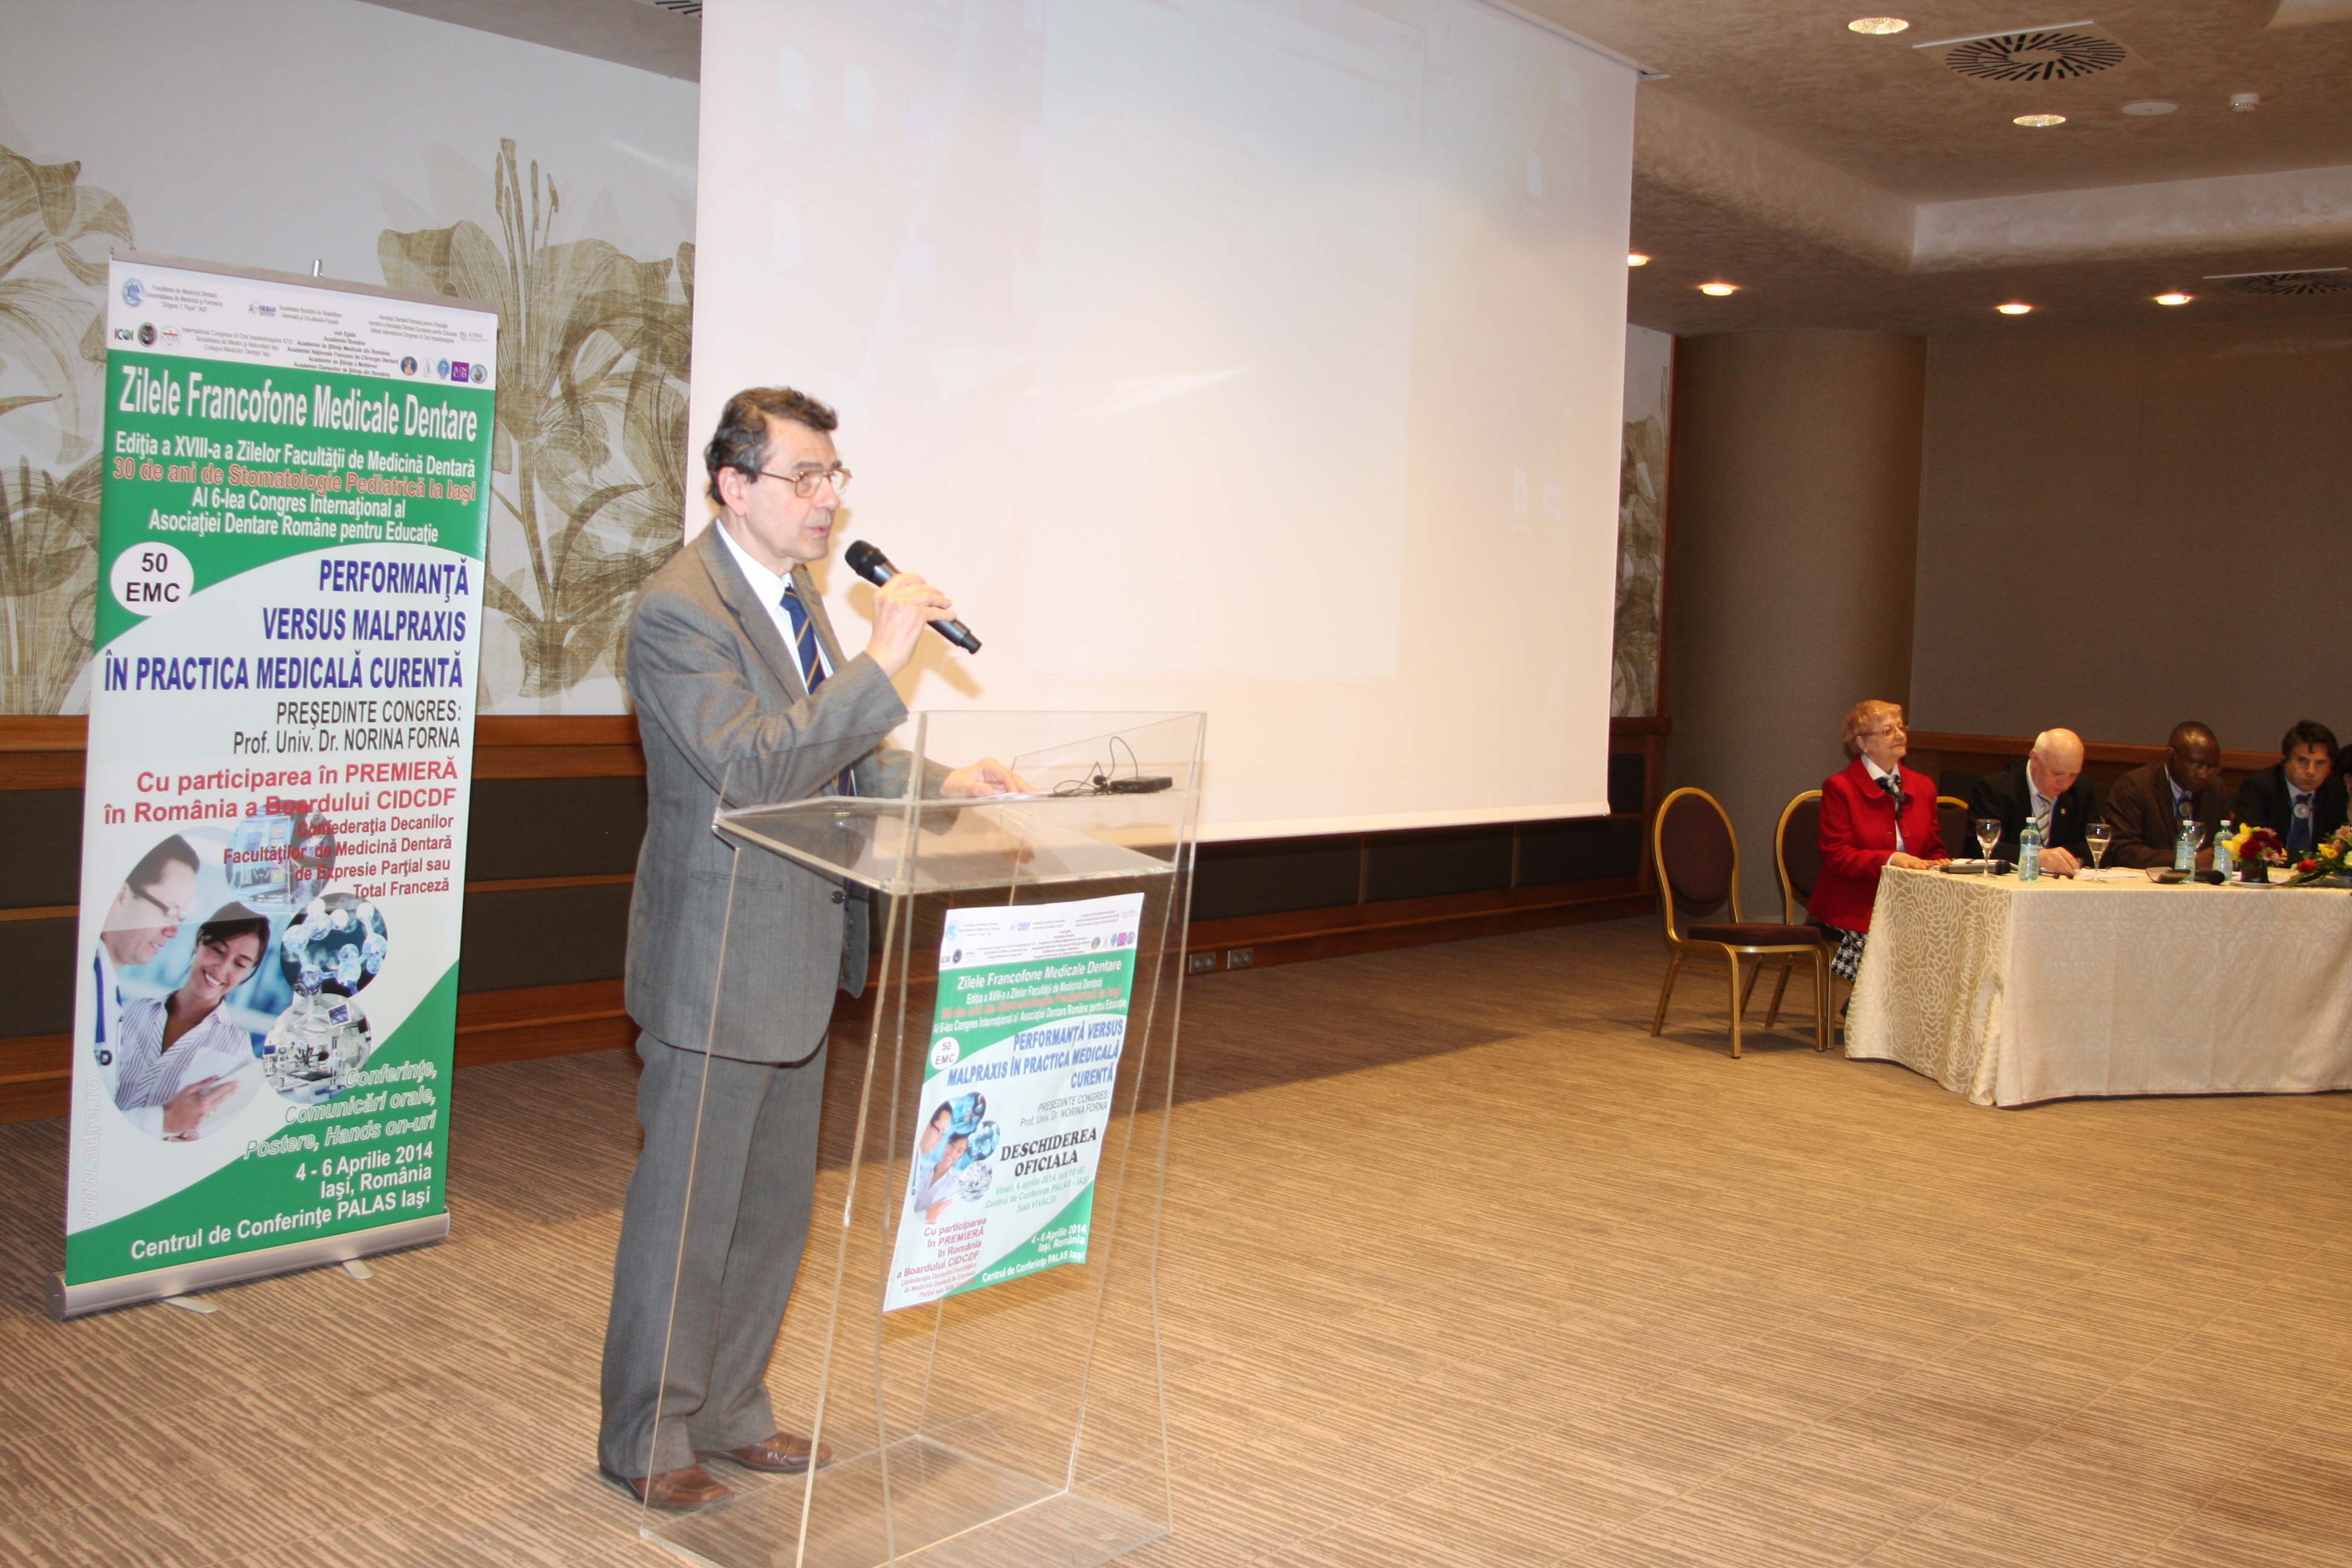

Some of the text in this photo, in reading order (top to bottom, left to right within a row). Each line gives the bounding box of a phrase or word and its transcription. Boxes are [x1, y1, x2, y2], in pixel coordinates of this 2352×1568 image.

[119, 365, 477, 442] Zilele Francofone Medicale Dentare
[161, 439, 171, 456] a
[174, 435, 221, 459] XVIII-a
[224, 444, 233, 460] a
[235, 440, 281, 463] Zilelor
[348, 449, 364, 469] de
[367, 450, 423, 474] Medicină
[426, 455, 475, 478] Dentară
[112, 456, 136, 479] 30
[139, 458, 164, 481] de
[167, 461, 197, 483] ani
[200, 462, 224, 485] de
[227, 463, 342, 495] Stomatologie
[345, 471, 425, 501] Pediatrică
[428, 478, 443, 498] la
[191, 486, 208, 507] Al
[211, 487, 246, 509] 6-lea
[248, 489, 307, 515] Congres
[394, 500, 406, 518] al
[224, 512, 279, 535] Dentare
[282, 517, 337, 538] Române
[339, 519, 382, 541] pentru
[141, 553, 168, 573] 50
[126, 583, 181, 603] EMC
[263, 607, 465, 641] VERSUS MALPRAXIS
[105, 649, 462, 691] ÎN PRACTICA MEDICALĂ CURENTĂ
[382, 700, 461, 722] CONGRES:
[234, 727, 460, 754] Prof. Univ. Dr. NORINA FORNA
[138, 757, 457, 795] Cu participarea în PREMIERĂ
[105, 788, 456, 824] în România a Boardului CIDCDF
[391, 815, 454, 831] Decanilor
[315, 845, 332, 859] de
[335, 839, 397, 858] Medicină
[401, 836, 452, 852] Dentară
[293, 866, 312, 881] de
[315, 865, 377, 881] Expresie
[427, 860, 450, 871] sau
[354, 878, 449, 898] Total Franceză
[957, 975, 985, 990] Zilele
[987, 969, 1042, 986] Francofone
[1045, 963, 1085, 978] Medicale
[1087, 960, 1122, 974] Dentare
[1087, 1019, 1123, 1039] VERSUS
[935, 1053, 955, 1065] EMC
[942, 1042, 952, 1051] 50
[947, 1061, 1008, 1086] MALPRAXIS
[1010, 1056, 1021, 1077] ÎN
[1023, 1051, 1070, 1074] PRACTICA
[286, 1085, 436, 1125] Comunicări orale,
[1077, 1090, 1109, 1105] CONGRES:
[1020, 1117, 1036, 1128] Prof.
[1050, 1111, 1060, 1121] Dr.
[1060, 1106, 1085, 1118] NORINA
[1085, 1101, 1108, 1114] FORNA
[244, 1111, 436, 1160] Postere, Hands on-uri
[1000, 1127, 1097, 1161] DESCHIDEREA
[81, 1074, 102, 1230] www.adre.ro
[295, 1163, 306, 1181] 4
[322, 1158, 332, 1177] 6
[336, 1150, 391, 1175] Aprilie
[395, 1142, 433, 1164] 2014
[1014, 1149, 1078, 1177] OFICIALA
[360, 1163, 431, 1191] România
[985, 1197, 1010, 1209] Centrul
[1051, 1180, 1072, 1192] PALAS
[1031, 1195, 1057, 1207] VIVALDI
[131, 1229, 202, 1259] Centrul
[208, 1225, 231, 1244] de
[337, 1192, 396, 1220] PALAS
[924, 1217, 987, 1236] Cu participarea
[1040, 1232, 1045, 1241] 6
[1045, 1227, 1067, 1240] Aprilie
[1068, 1223, 1086, 1234] 2014
[927, 1239, 936, 1248] în
[938, 1240, 982, 1258] în România
[904, 1259, 946, 1276] Boardului
[948, 1250, 980, 1267] CIDCDF
[982, 1267, 1005, 1282] Centrul
[1007, 1266, 1015, 1276] de
[1048, 1250, 1068, 1264] PALAS
